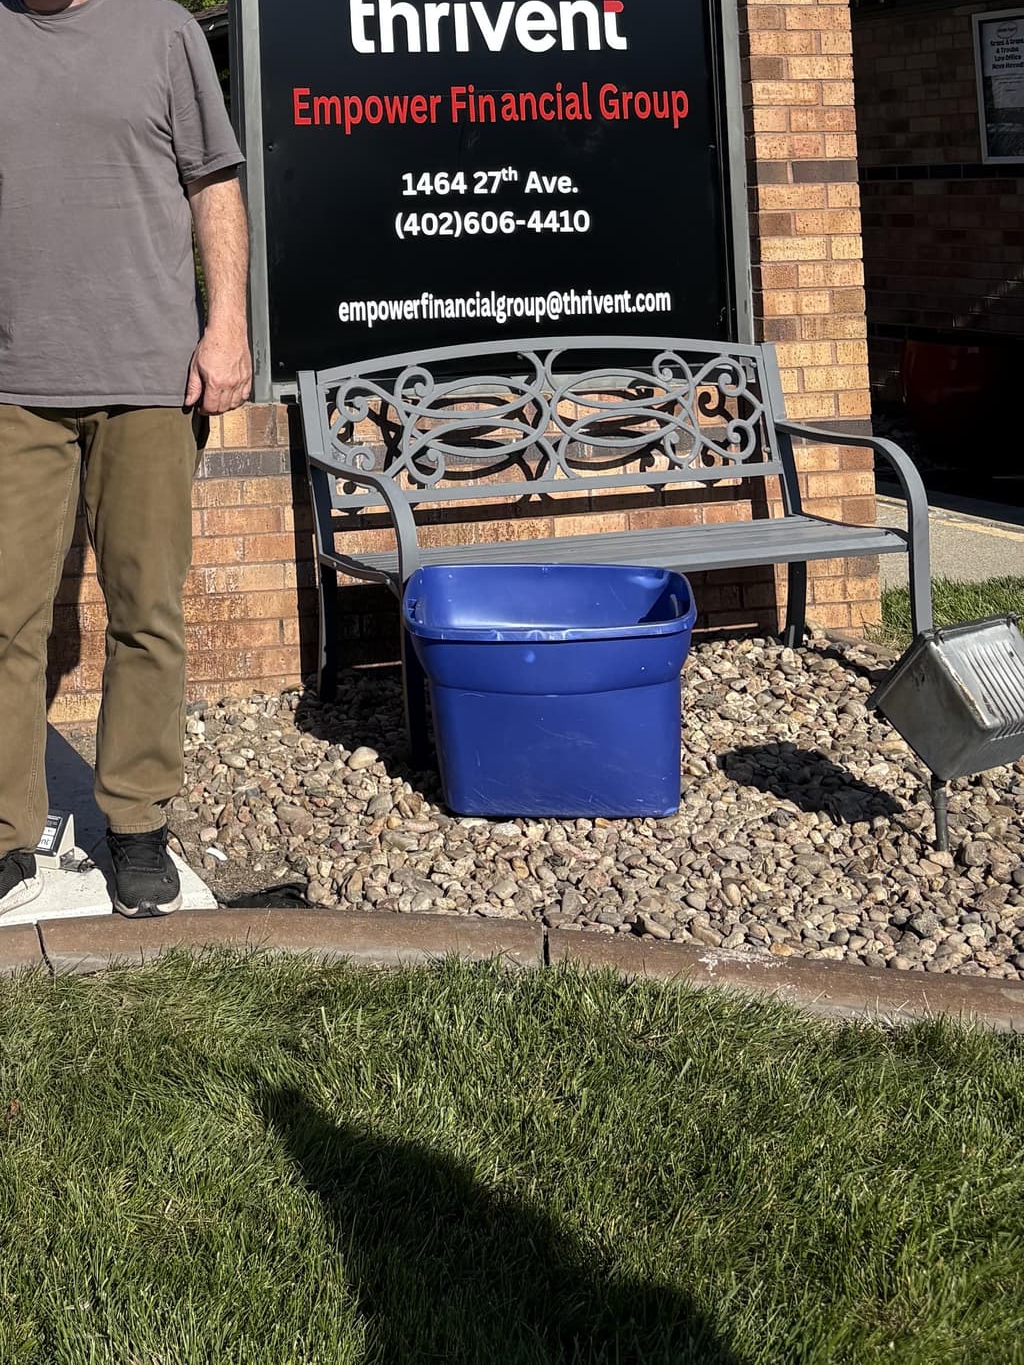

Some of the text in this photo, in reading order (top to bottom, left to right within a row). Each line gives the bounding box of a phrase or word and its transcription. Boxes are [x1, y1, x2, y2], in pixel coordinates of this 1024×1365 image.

[293, 81, 689, 135] Empower Financial Group
[401, 165, 579, 196] 1464 27th Ave.
[394, 209, 591, 240] (402)606-4410
[338, 288, 672, 328] empowerfinancialgroup@thrivent.com
